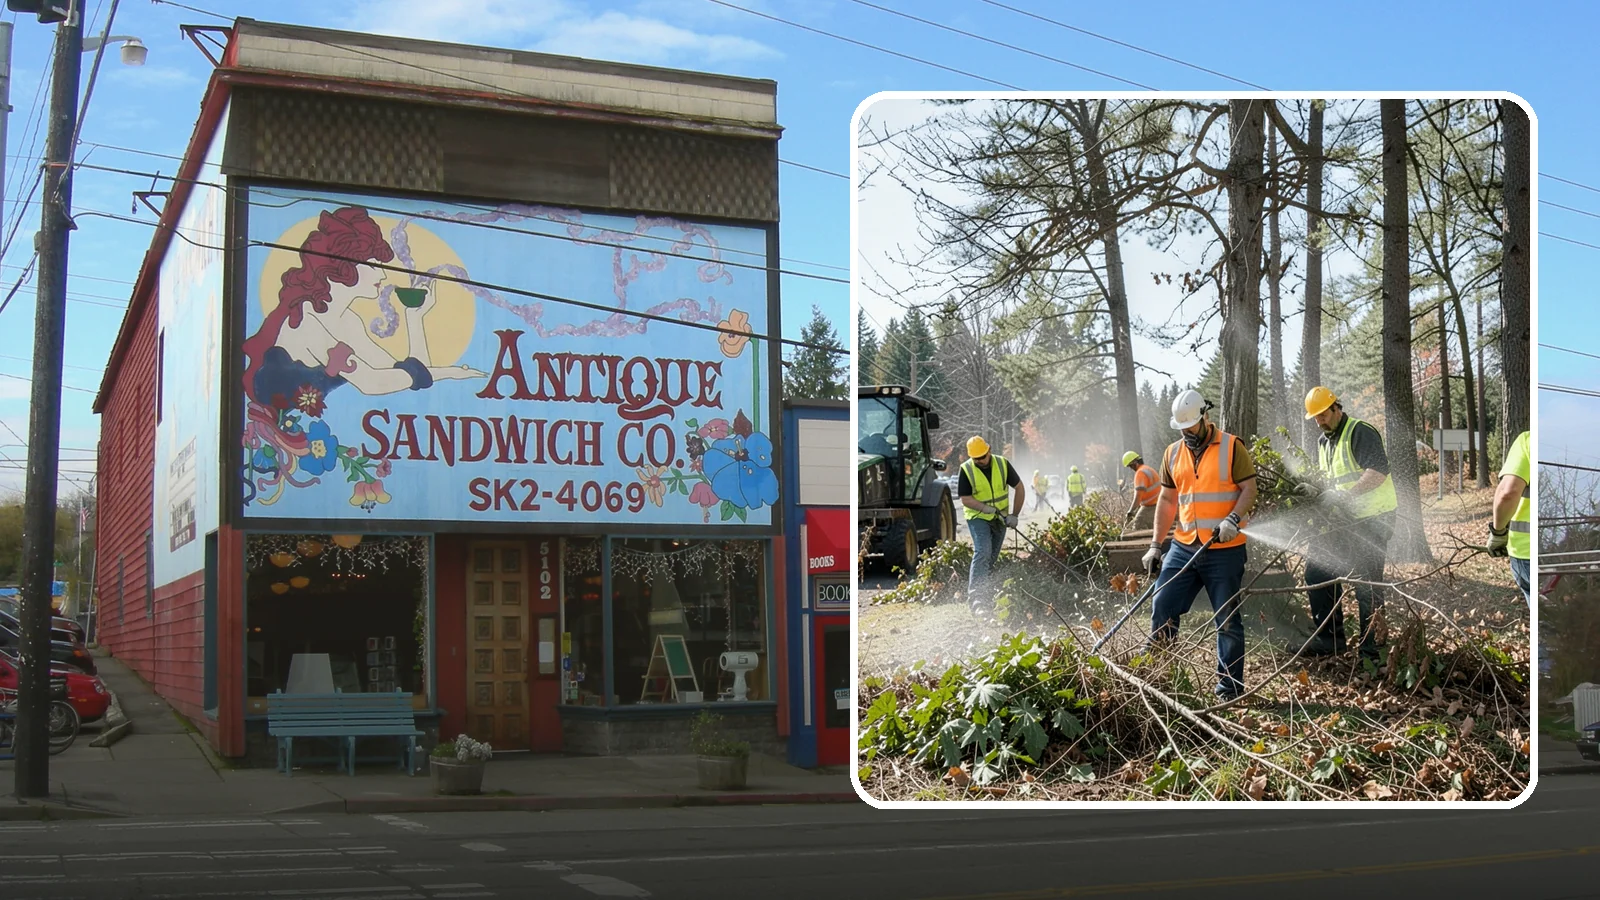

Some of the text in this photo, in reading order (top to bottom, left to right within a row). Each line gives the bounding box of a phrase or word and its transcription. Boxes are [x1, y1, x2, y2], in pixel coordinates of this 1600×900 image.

[476, 329, 724, 421] ANTIQUE
[361, 408, 685, 470] SANDWICH CO.
[468, 477, 646, 514] SK2-4069
[540, 542, 551, 599] 5102
[809, 555, 835, 569] BOOKS
